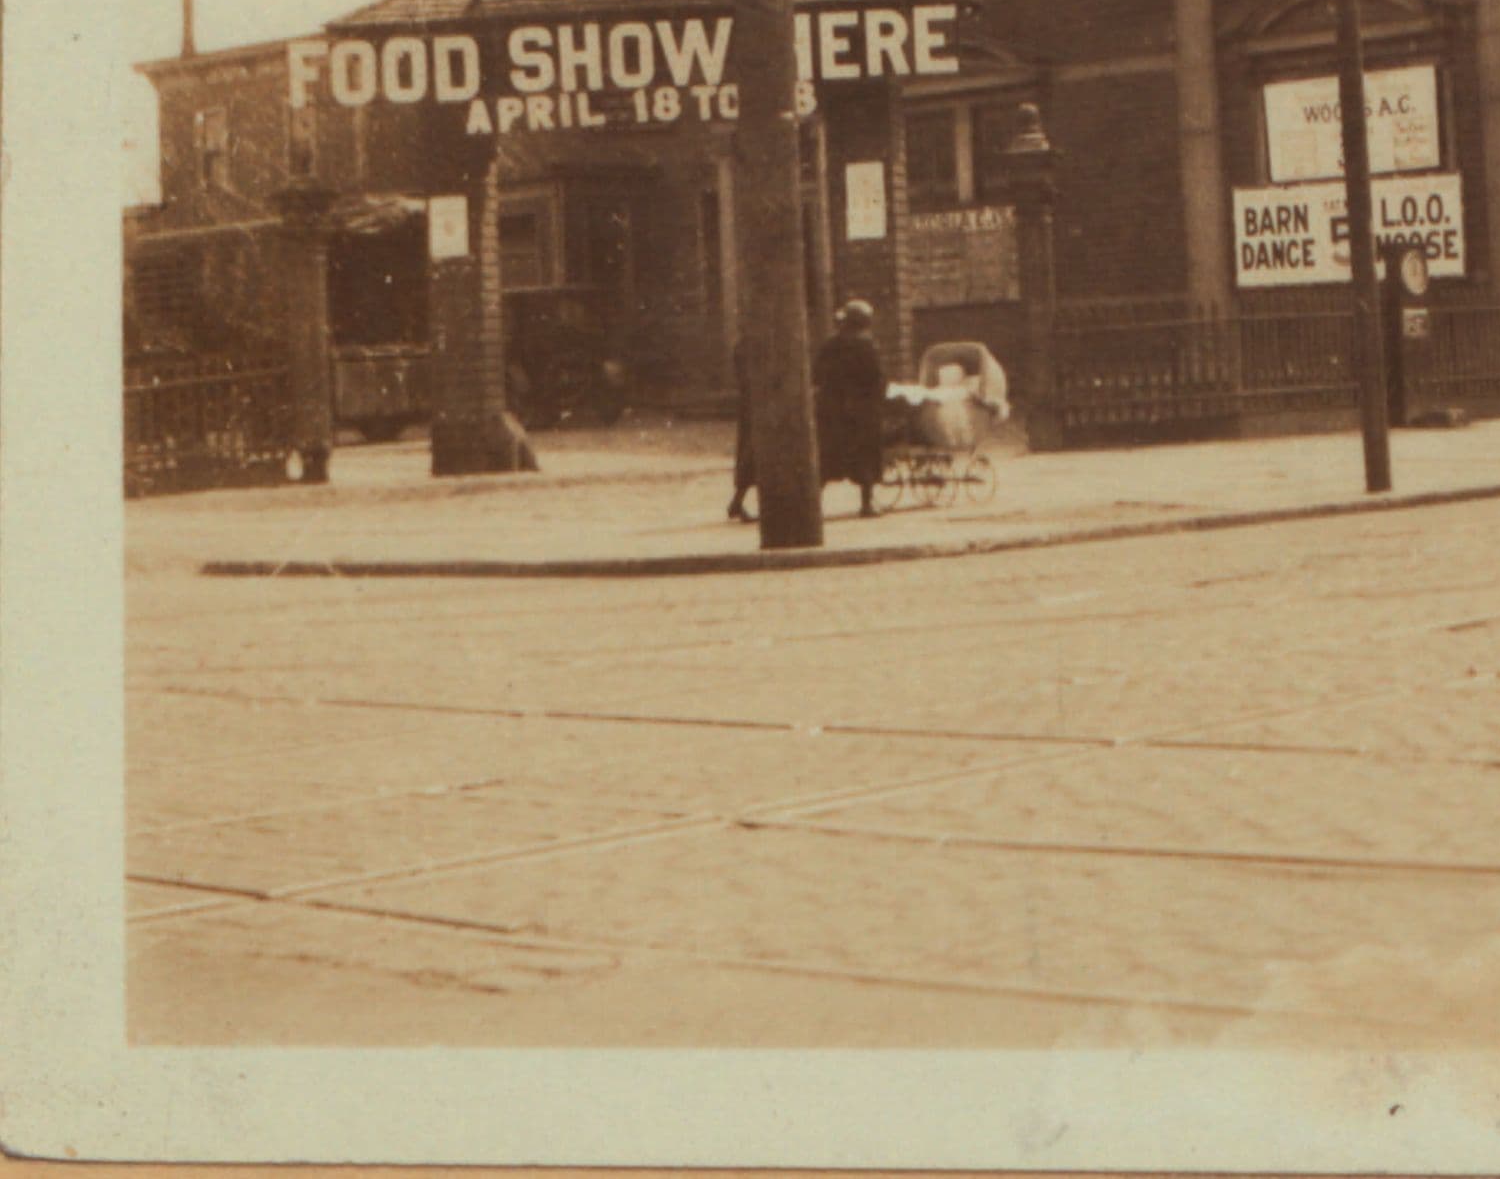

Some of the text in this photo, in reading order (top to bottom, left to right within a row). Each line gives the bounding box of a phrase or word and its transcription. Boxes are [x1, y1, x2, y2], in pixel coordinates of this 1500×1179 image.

[286, 35, 481, 109] FOOD
[507, 16, 735, 93] SHOW
[465, 88, 607, 135] APRIL
[632, 85, 683, 123] 18
[690, 83, 740, 121] TO
[1377, 92, 1417, 118] A.C.
[1244, 203, 1310, 237] BARN
[1240, 238, 1316, 271] DANCE
